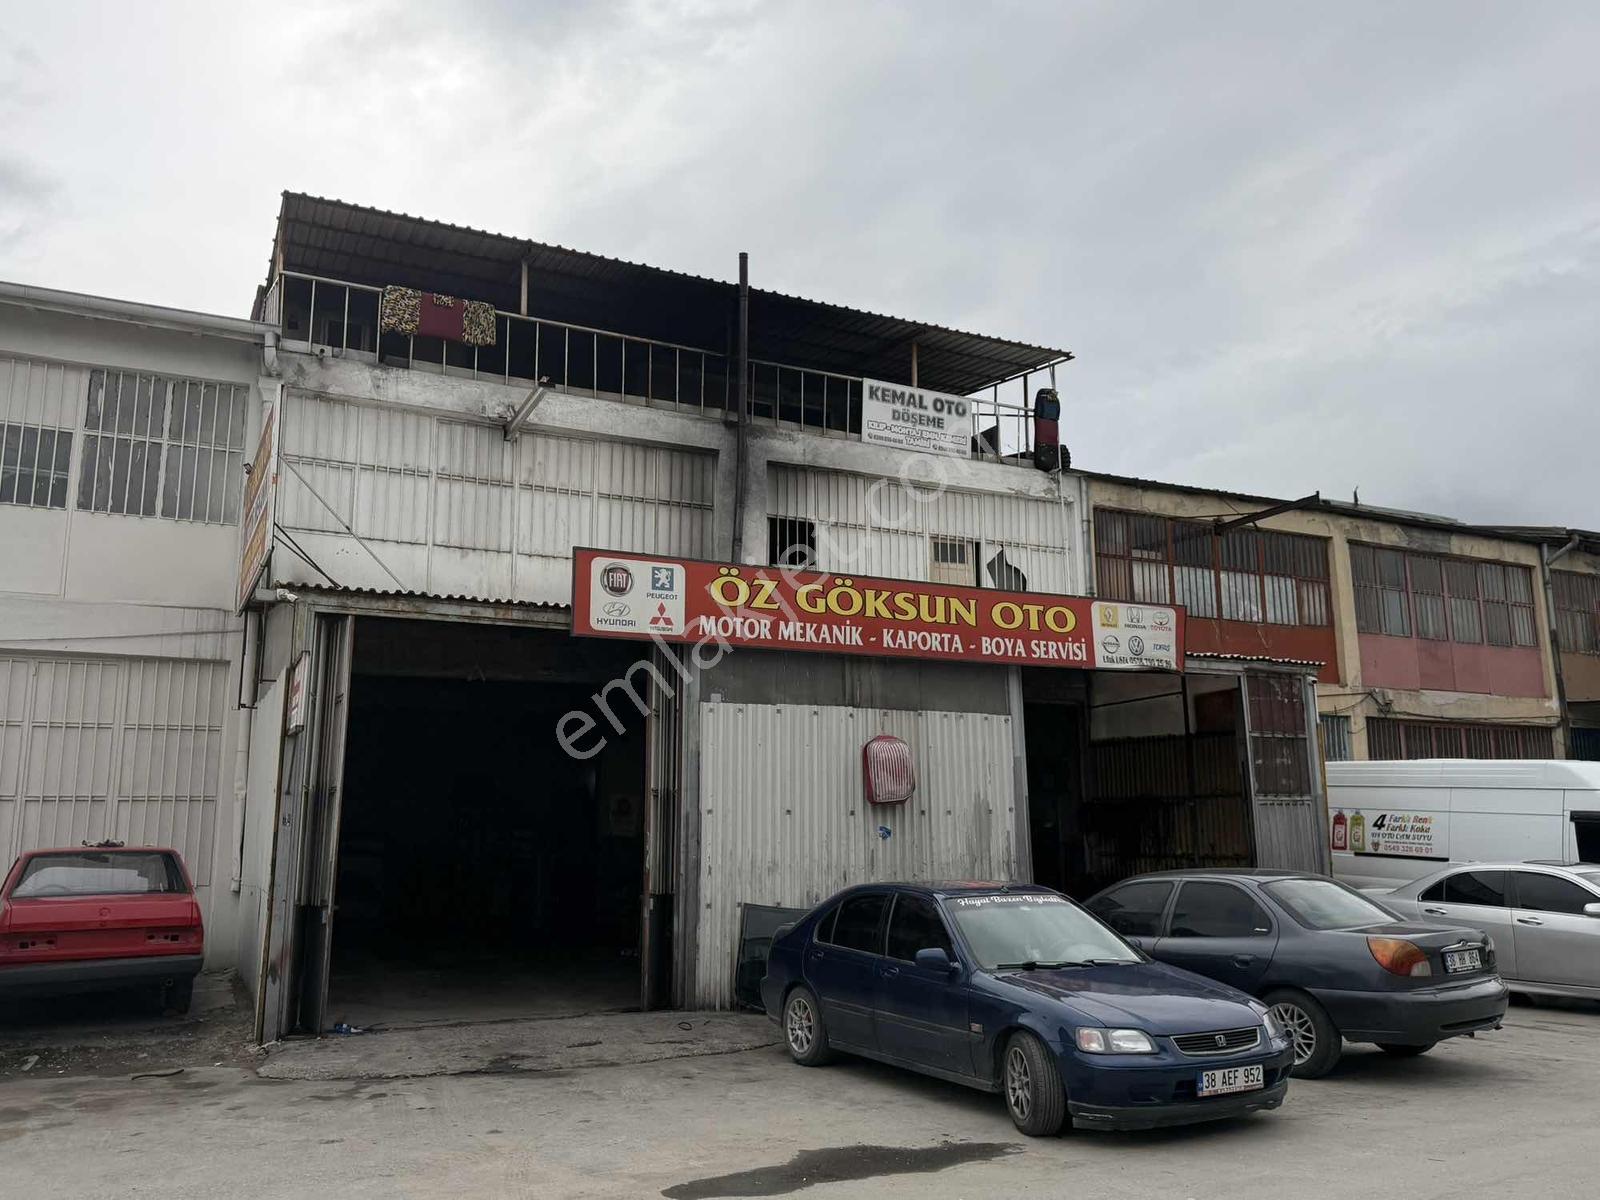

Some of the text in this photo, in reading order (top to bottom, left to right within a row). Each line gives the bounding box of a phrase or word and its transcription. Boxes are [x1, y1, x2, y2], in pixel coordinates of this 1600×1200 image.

[868, 385, 967, 417] KEMAL OTO
[892, 408, 945, 430] DÖŞEME
[608, 572, 627, 588] FIAT
[646, 592, 678, 600] PEUGEOT
[710, 567, 1077, 633] ÖZ GÖKSUN OTO
[596, 618, 636, 627] HYUNDAI
[698, 614, 772, 640] MOTOR
[778, 620, 863, 646] MEKANİK
[882, 629, 963, 654] KAPORTA
[981, 636, 1027, 658] BOYA
[1031, 637, 1087, 661] SERVİSİ
[1371, 814, 1387, 830] 4
[957, 897, 990, 907] Hayat
[990, 895, 1023, 903] Bazen
[1204, 1067, 1261, 1089] 38 AEF 952
